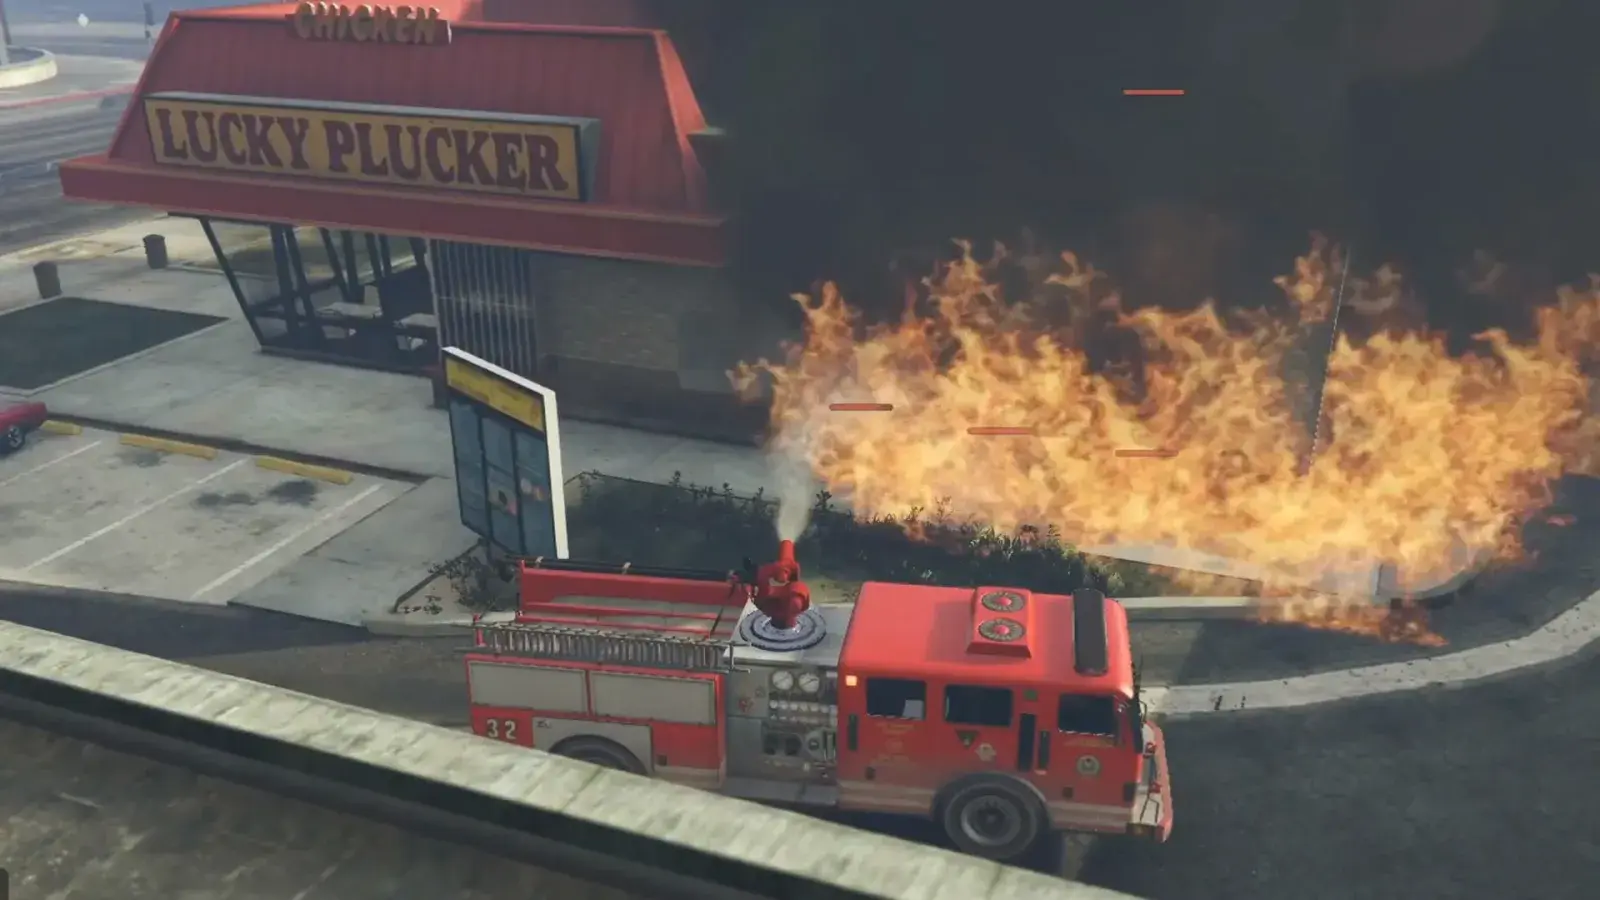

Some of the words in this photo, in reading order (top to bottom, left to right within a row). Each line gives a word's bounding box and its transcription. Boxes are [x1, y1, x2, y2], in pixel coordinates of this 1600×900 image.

[294, 1, 440, 44] CHICKEN
[156, 108, 309, 169] LUCKY
[324, 119, 569, 193] PLUCKER
